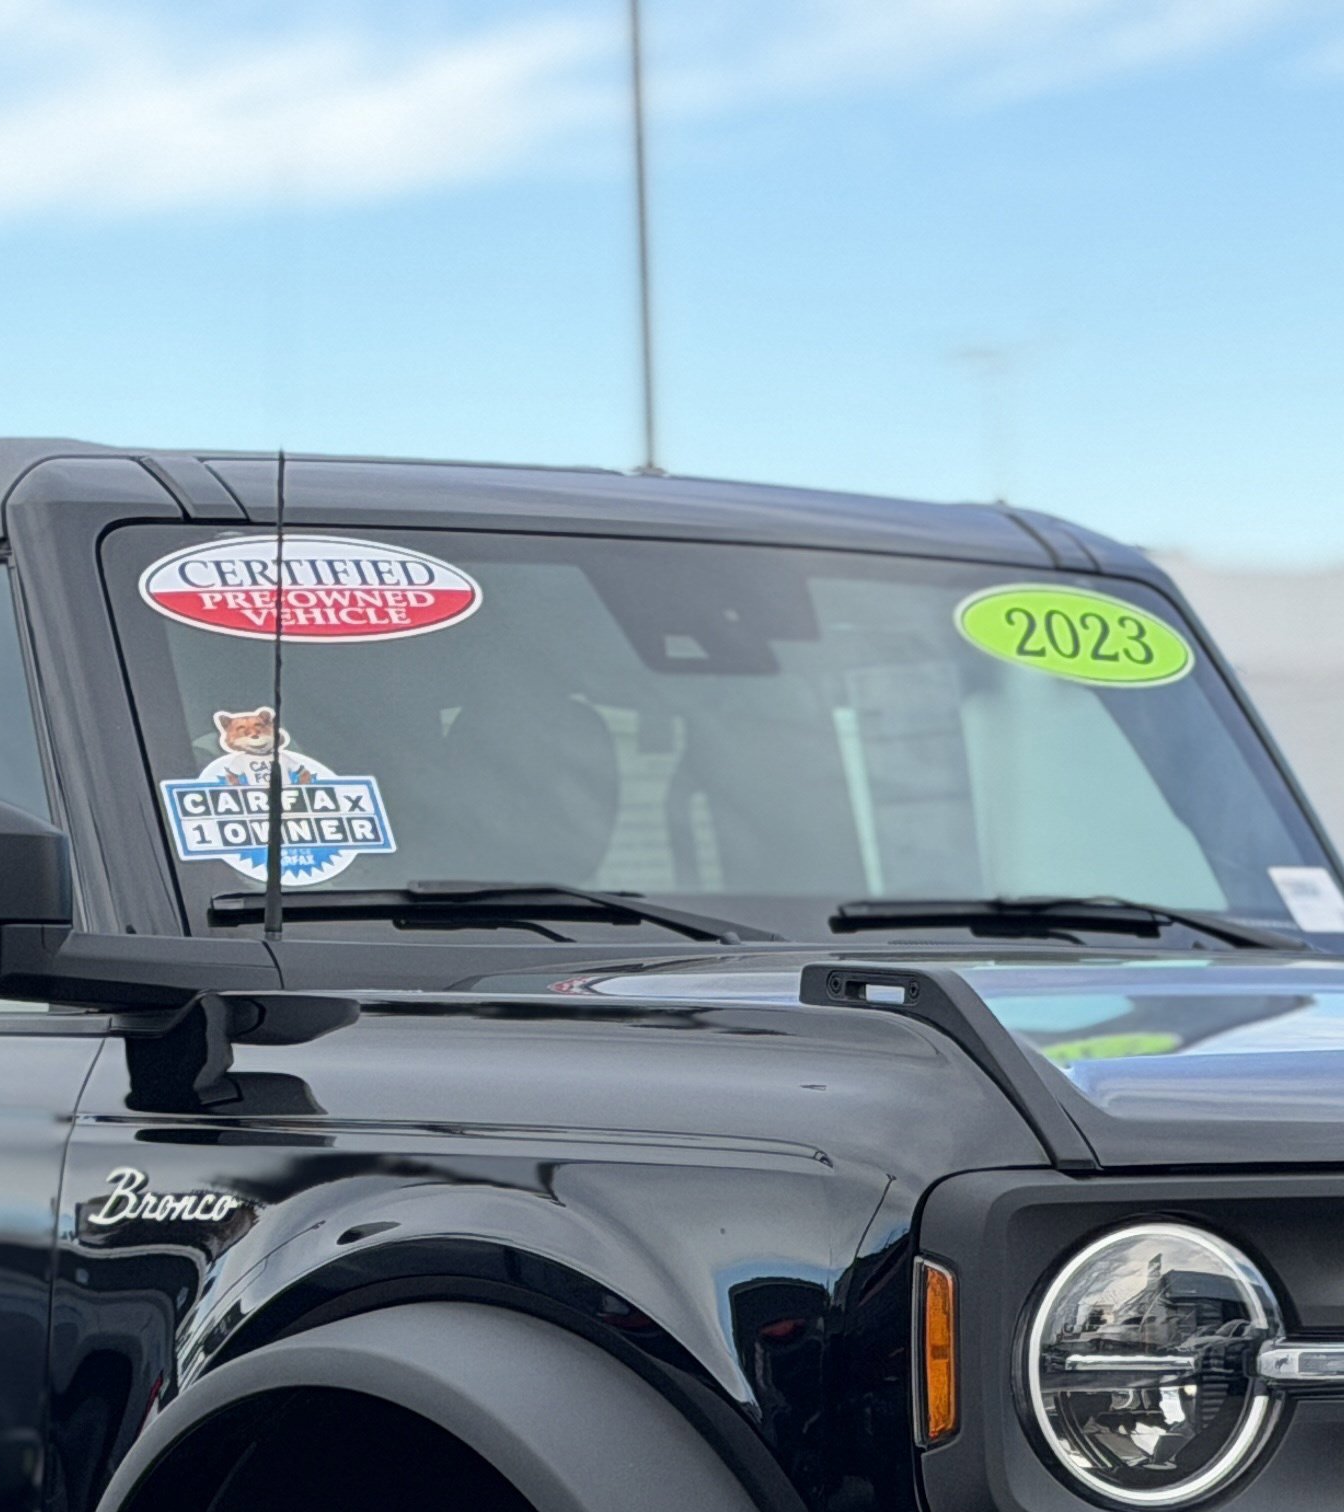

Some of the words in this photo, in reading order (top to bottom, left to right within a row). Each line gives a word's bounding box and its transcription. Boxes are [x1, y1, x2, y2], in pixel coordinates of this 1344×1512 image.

[177, 558, 436, 589] CERTIFIED
[198, 590, 436, 610] PRE-OWNED
[240, 607, 412, 627] VEHICLE
[1004, 606, 1155, 665] 2023
[181, 789, 365, 815] CARFAX
[192, 822, 213, 846] 1
[88, 1166, 243, 1226] Bronco
